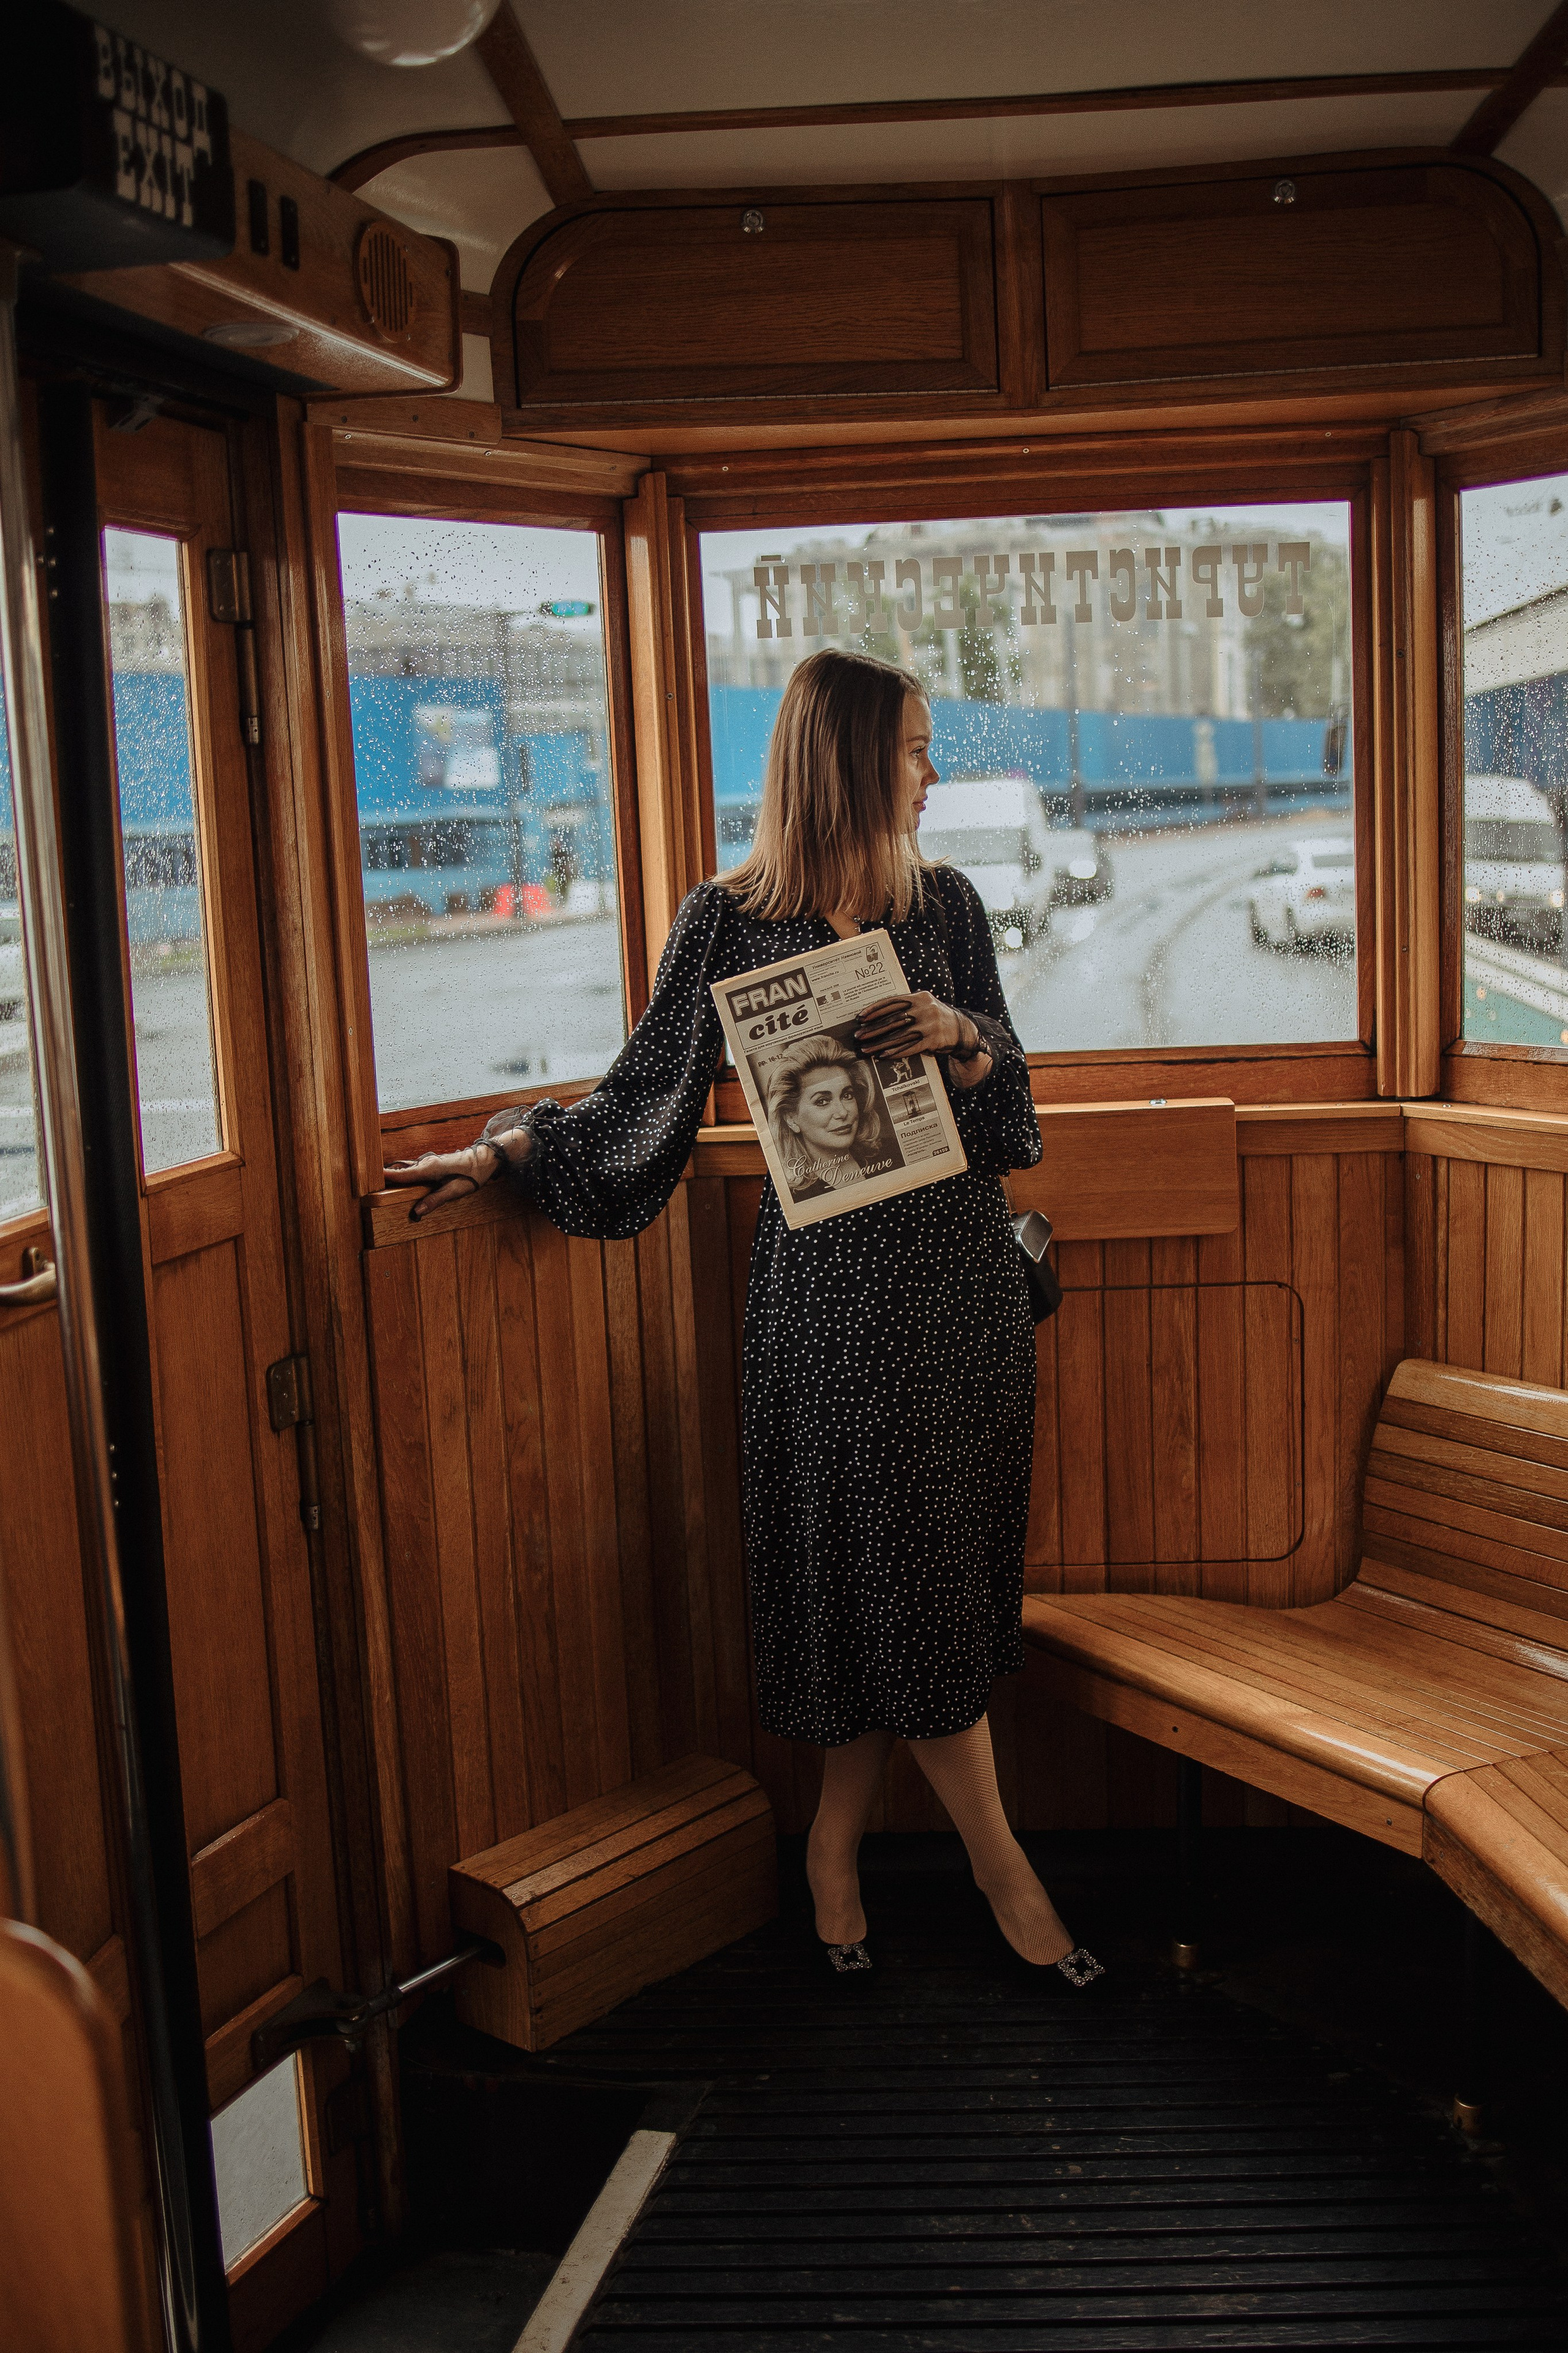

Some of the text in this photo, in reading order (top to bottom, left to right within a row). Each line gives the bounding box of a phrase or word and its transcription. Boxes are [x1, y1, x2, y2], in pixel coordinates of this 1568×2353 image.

[94, 23, 212, 165] ВЫХОД
[113, 107, 195, 227] EXIT
[812, 957, 840, 970] Университет
[731, 974, 808, 1016] FRAN
[749, 1004, 809, 1040] cité
[788, 1028, 813, 1039] французский
[900, 1124, 938, 1138] Подписка
[787, 1154, 850, 1177] Catherine
[820, 1158, 892, 1188] Deneuve
